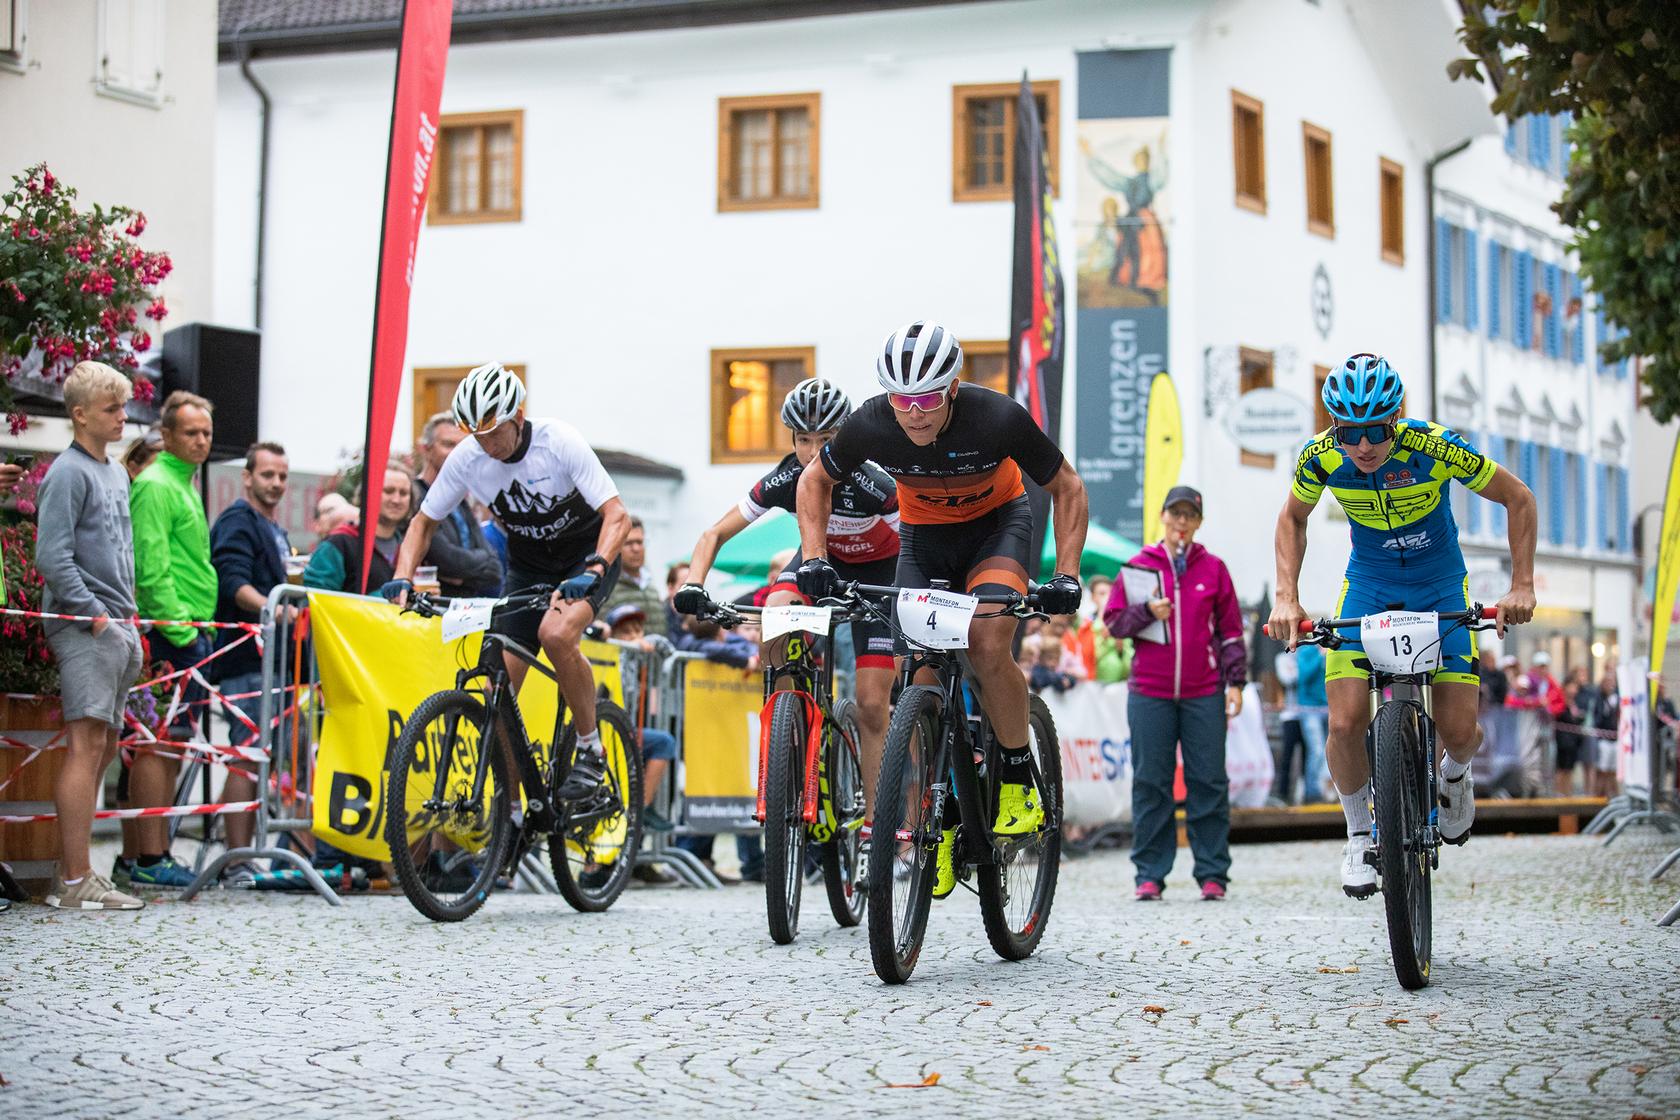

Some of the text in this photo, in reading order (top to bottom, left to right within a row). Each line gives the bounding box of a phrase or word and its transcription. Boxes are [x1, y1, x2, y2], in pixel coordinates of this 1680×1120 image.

[1110, 318, 1143, 458] grenzen
[884, 465, 904, 474] BOA
[926, 610, 937, 630] 4
[1390, 634, 1412, 657] 13
